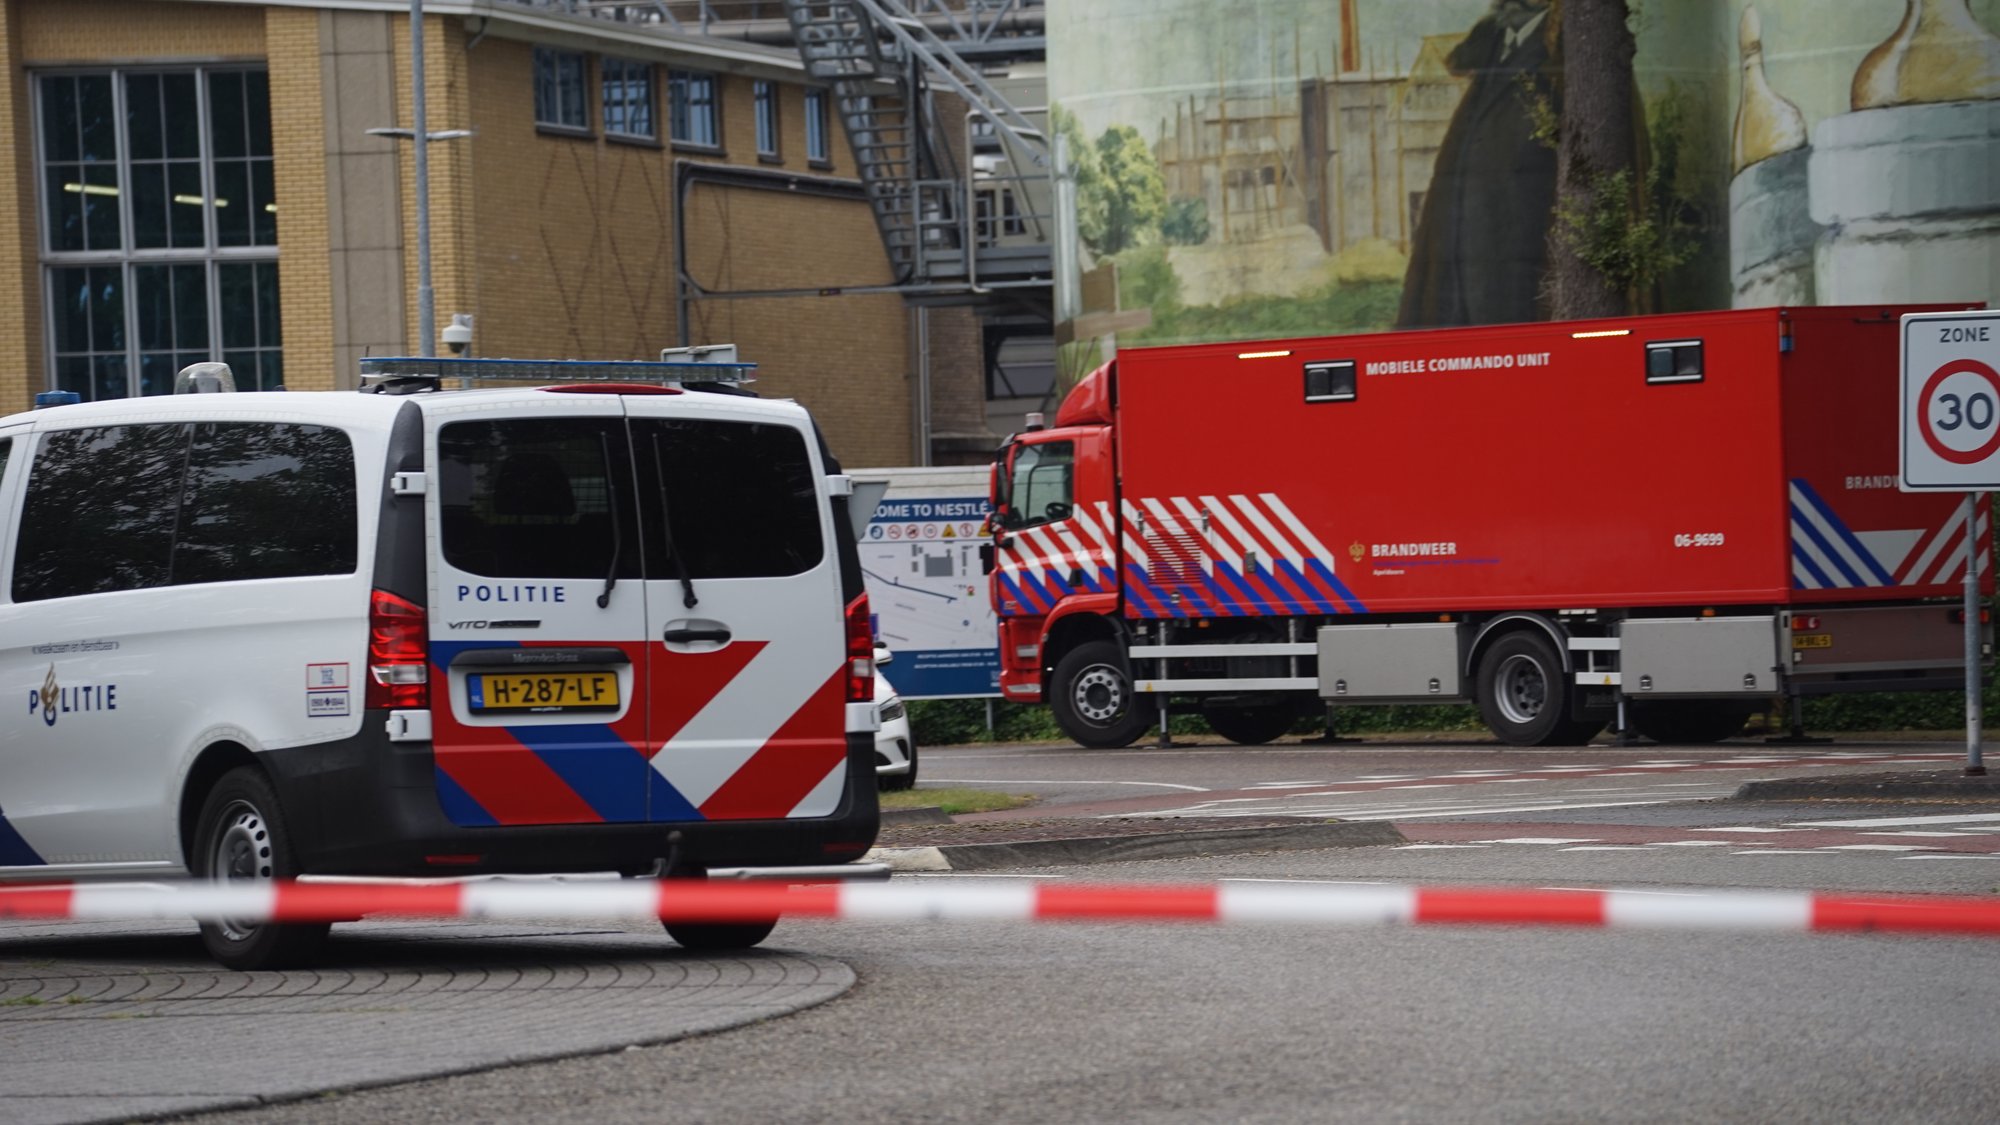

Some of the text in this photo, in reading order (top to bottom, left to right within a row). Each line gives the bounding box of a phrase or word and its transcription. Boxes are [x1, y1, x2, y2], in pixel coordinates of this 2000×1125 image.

[1939, 326, 1990, 343] ZONE
[1366, 352, 1551, 376] MOBIELE COMMANDO UNIT
[1936, 392, 1994, 431] 30
[912, 504, 932, 517] TO
[935, 500, 988, 516] NESTLÉ
[1674, 532, 1725, 548] 06-9699
[1371, 542, 1457, 557] BRANDWEER
[458, 585, 566, 602] POLITIE
[447, 620, 488, 630] VITO
[492, 677, 606, 704] H-287-LF
[29, 684, 117, 727] POLITIE
